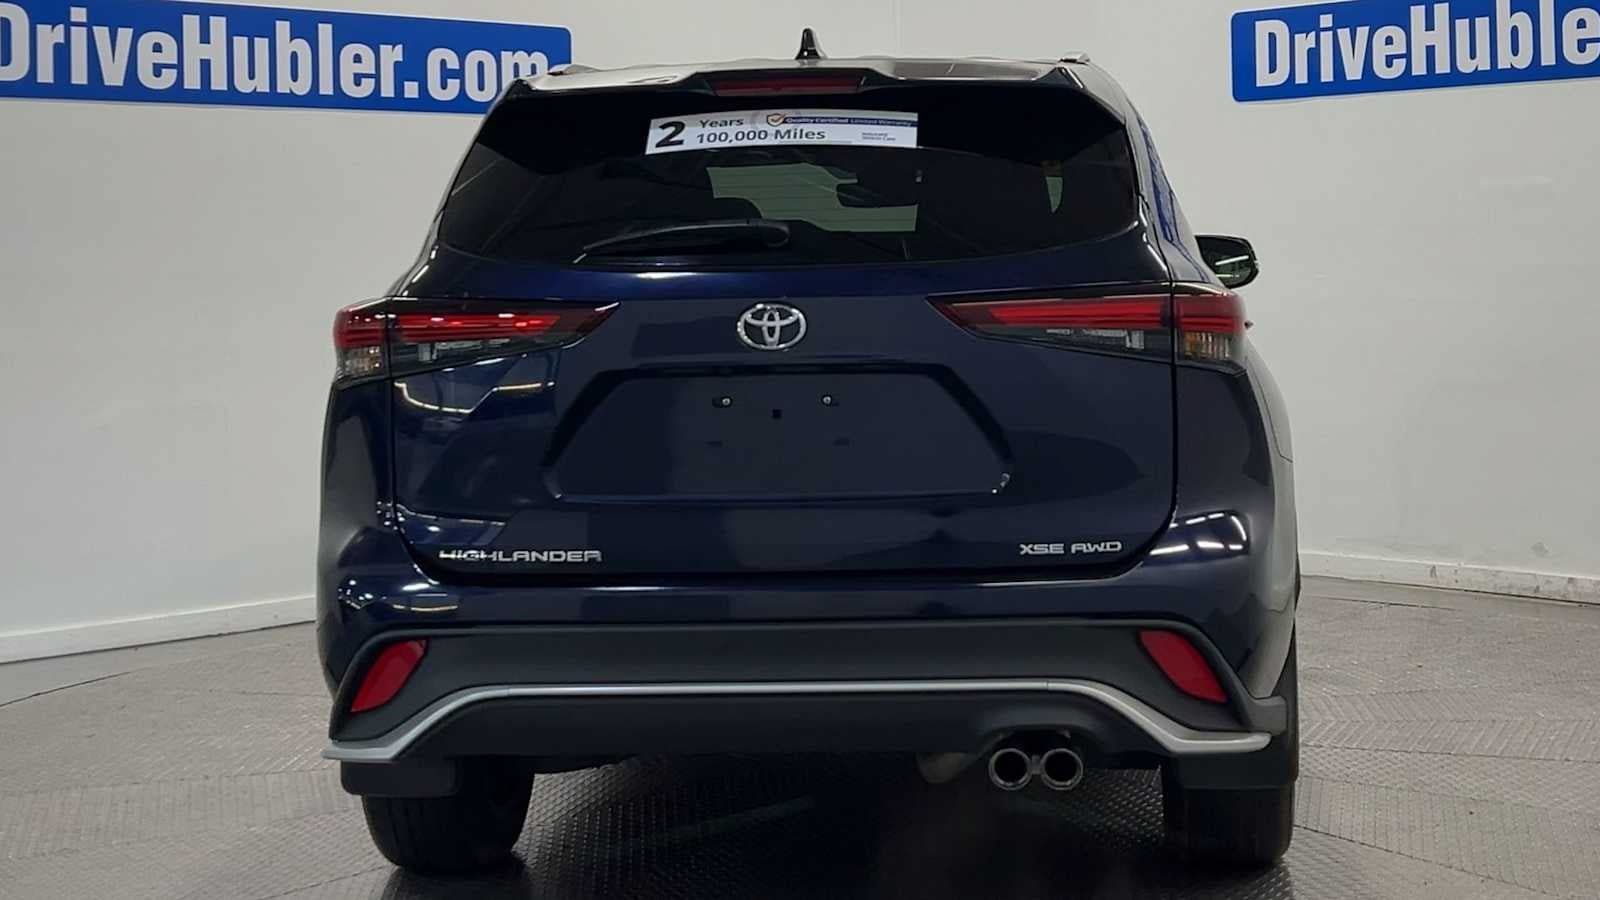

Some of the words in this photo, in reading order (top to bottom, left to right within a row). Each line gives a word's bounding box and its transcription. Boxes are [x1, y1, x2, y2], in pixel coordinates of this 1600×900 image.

[0, 2, 548, 102] DriveHubler.com
[700, 119, 744, 128] Years
[655, 121, 686, 148] 2
[697, 130, 768, 144] 100,000
[774, 128, 826, 140] Miles
[439, 549, 602, 562] HIGHLANDER
[1020, 543, 1065, 555] XSE
[1071, 541, 1122, 554] AWD
